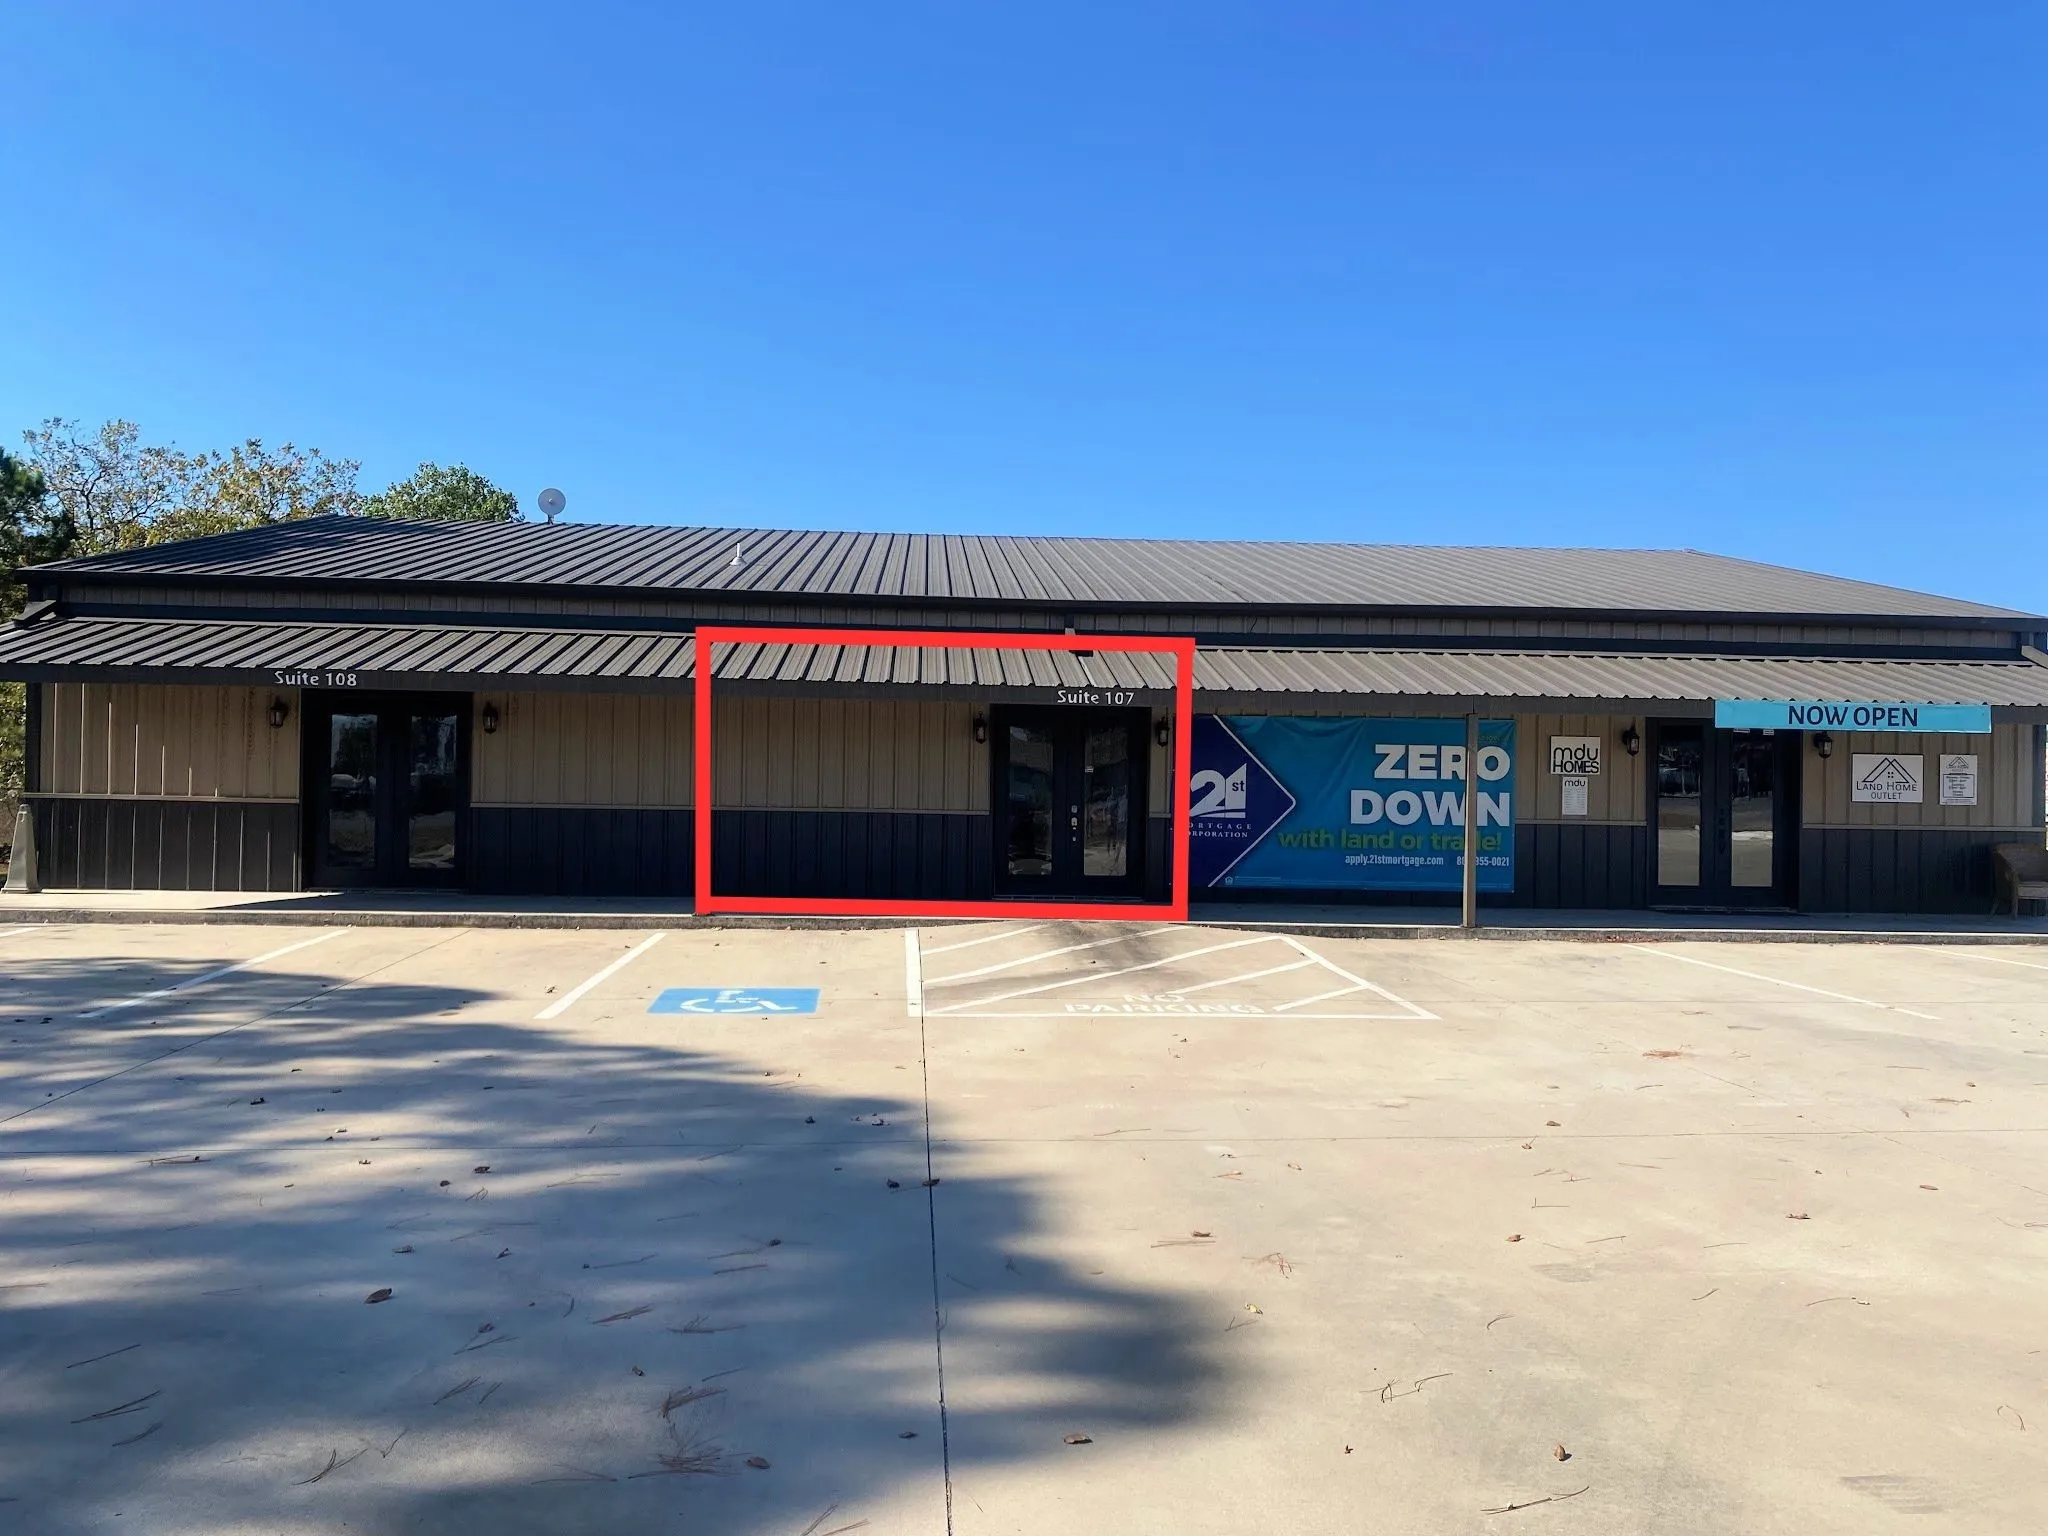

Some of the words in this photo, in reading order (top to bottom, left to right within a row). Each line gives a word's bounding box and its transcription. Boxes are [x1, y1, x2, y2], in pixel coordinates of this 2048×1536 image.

[274, 670, 319, 686] Suite
[325, 672, 357, 686] 108
[1057, 689, 1100, 704] Suite
[1105, 691, 1134, 705] 107
[1788, 705, 1849, 725] NOW
[1853, 706, 1918, 727] OPEN
[1553, 744, 1599, 760] mdu
[1374, 744, 1511, 781] ZERO
[1552, 760, 1600, 773] HOMES
[1564, 779, 1586, 787] mdu
[1856, 780, 1883, 791] LAND
[1886, 781, 1918, 792] HOME
[1870, 791, 1903, 800] OUTLET
[1351, 789, 1511, 827] DOWN
[1278, 828, 1335, 848] with
[1341, 828, 1395, 849] land
[1400, 833, 1423, 850] or
[1345, 853, 1444, 867] apply.21stmortgage.com
[1121, 994, 1185, 1003] NO
[1064, 1003, 1265, 1014] PARKING
